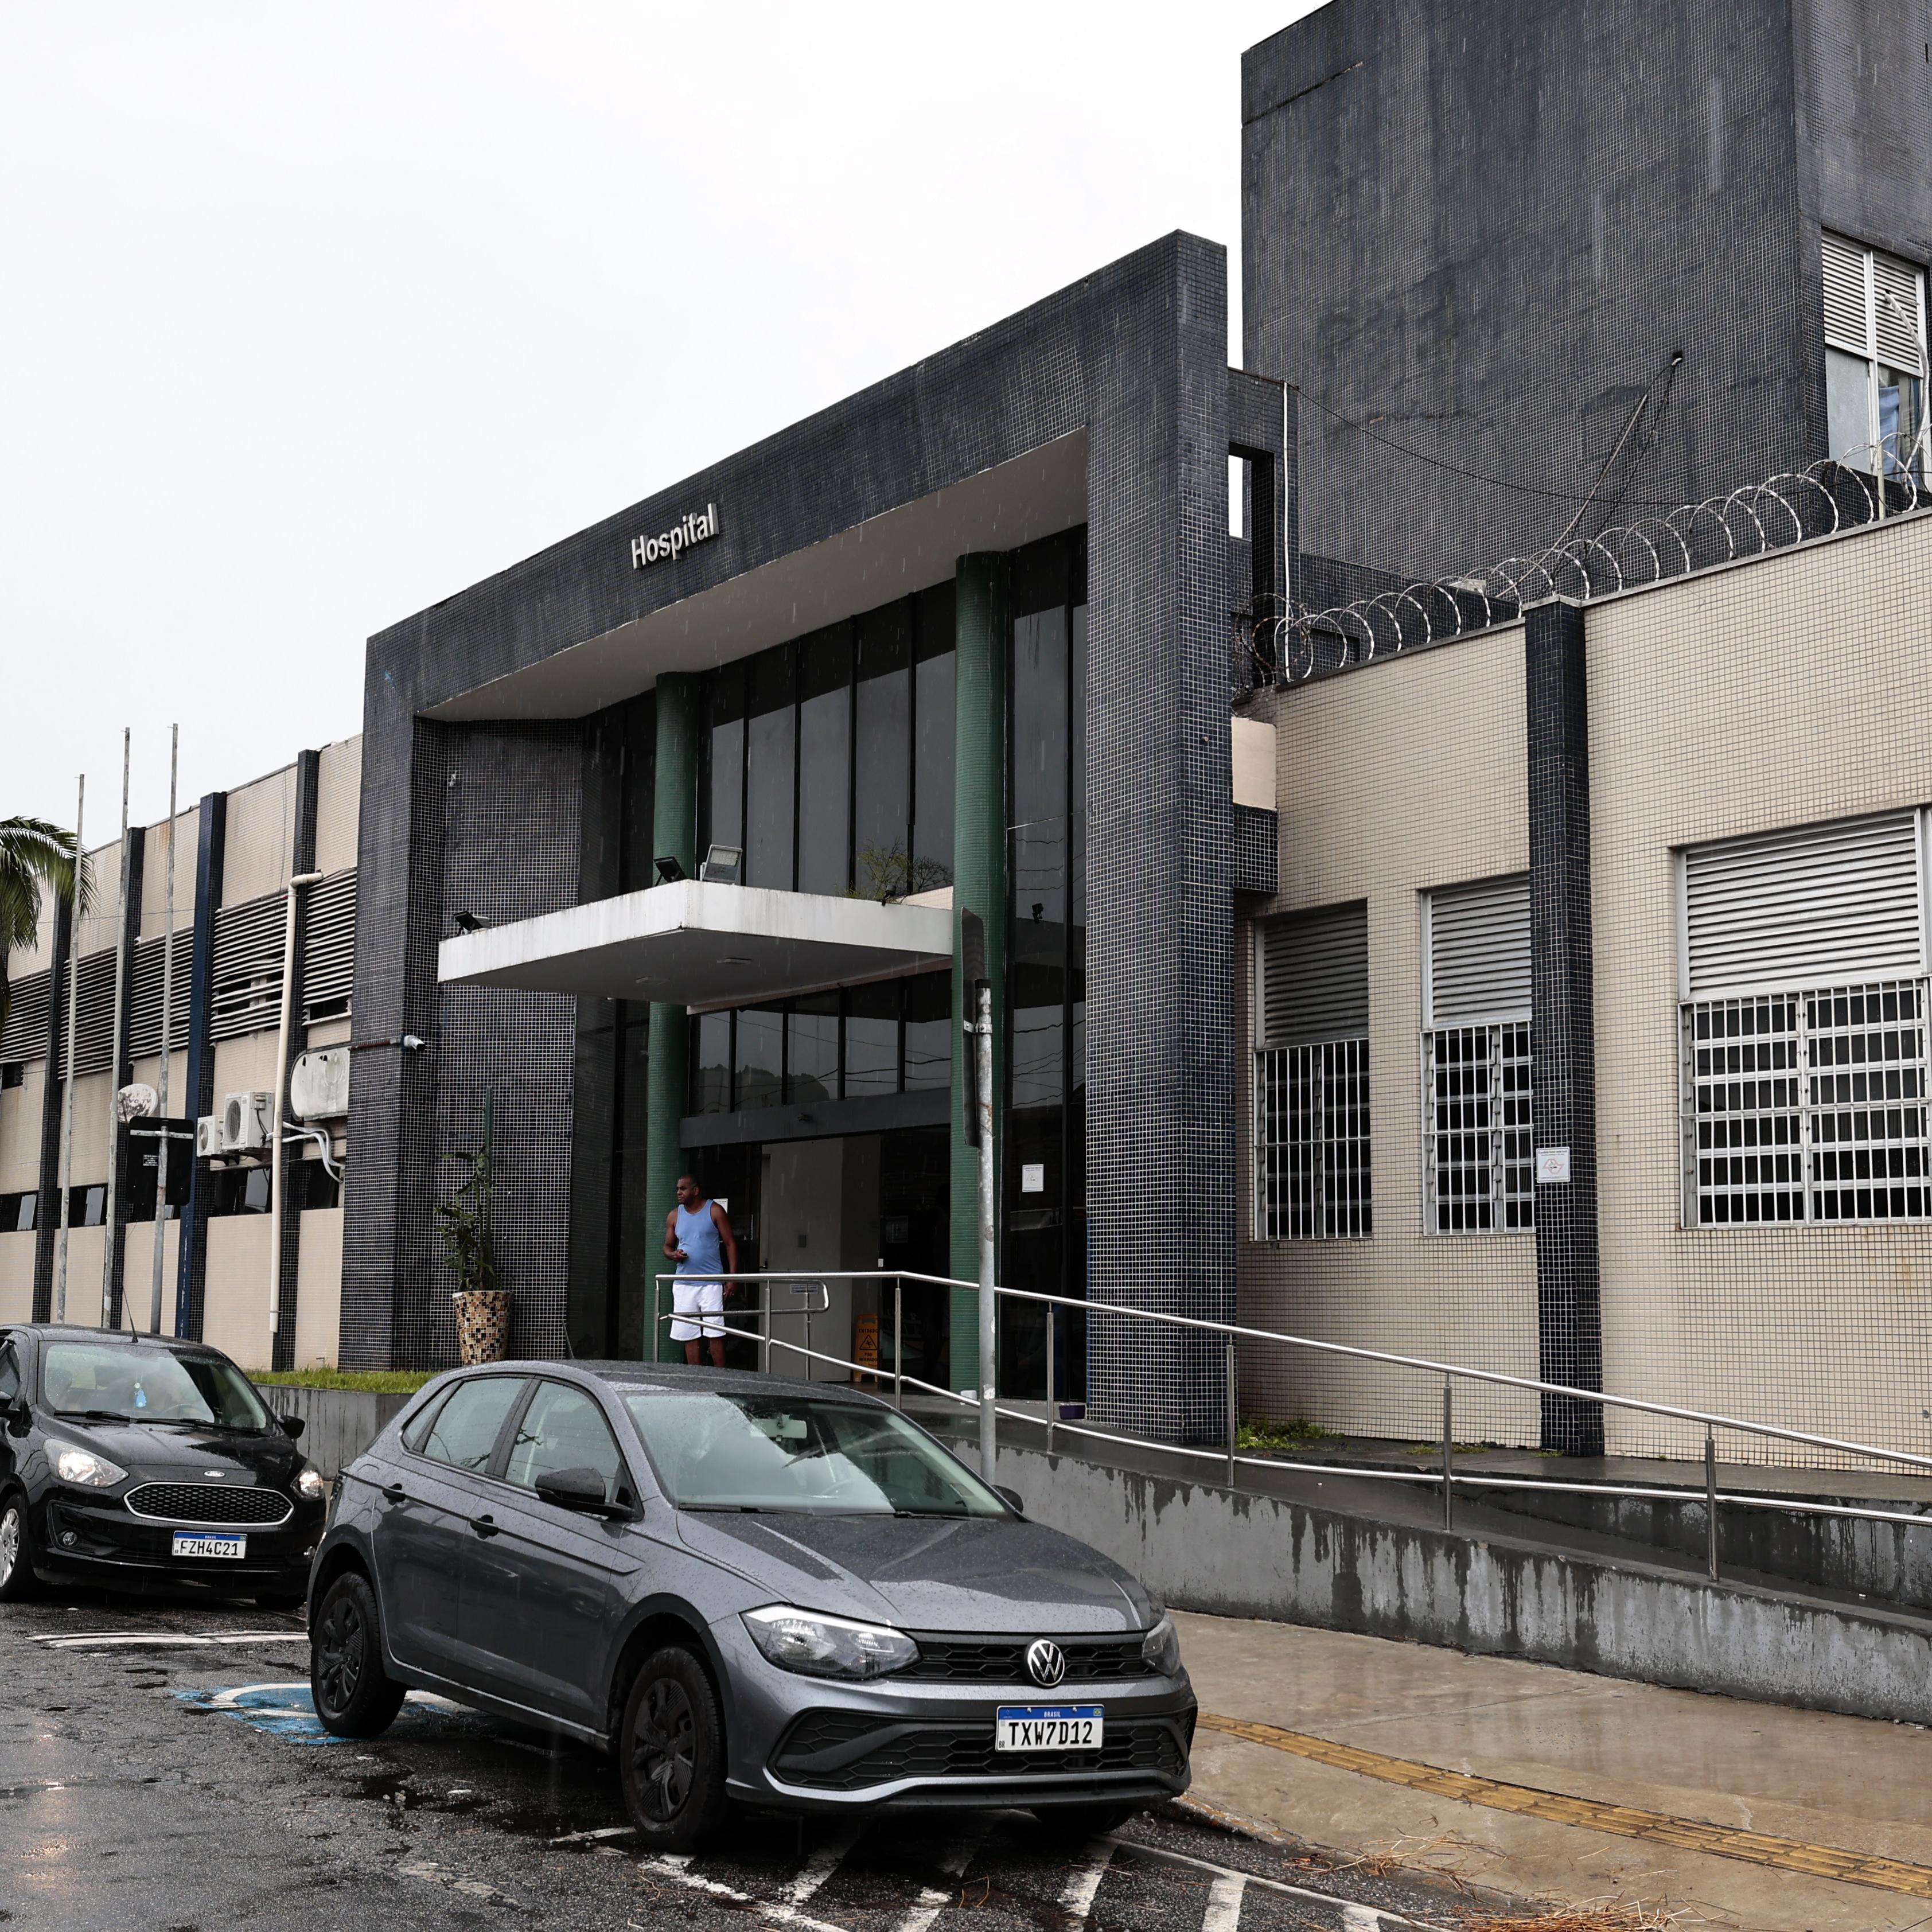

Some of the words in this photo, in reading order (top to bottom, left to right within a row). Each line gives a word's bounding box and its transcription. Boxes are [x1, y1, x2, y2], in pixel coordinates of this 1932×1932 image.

[631, 504, 719, 570] Hospital
[180, 1540, 238, 1556] FZH4C21
[1008, 1721, 1093, 1746] TXW7D12
[998, 1740, 1005, 1748] BR
